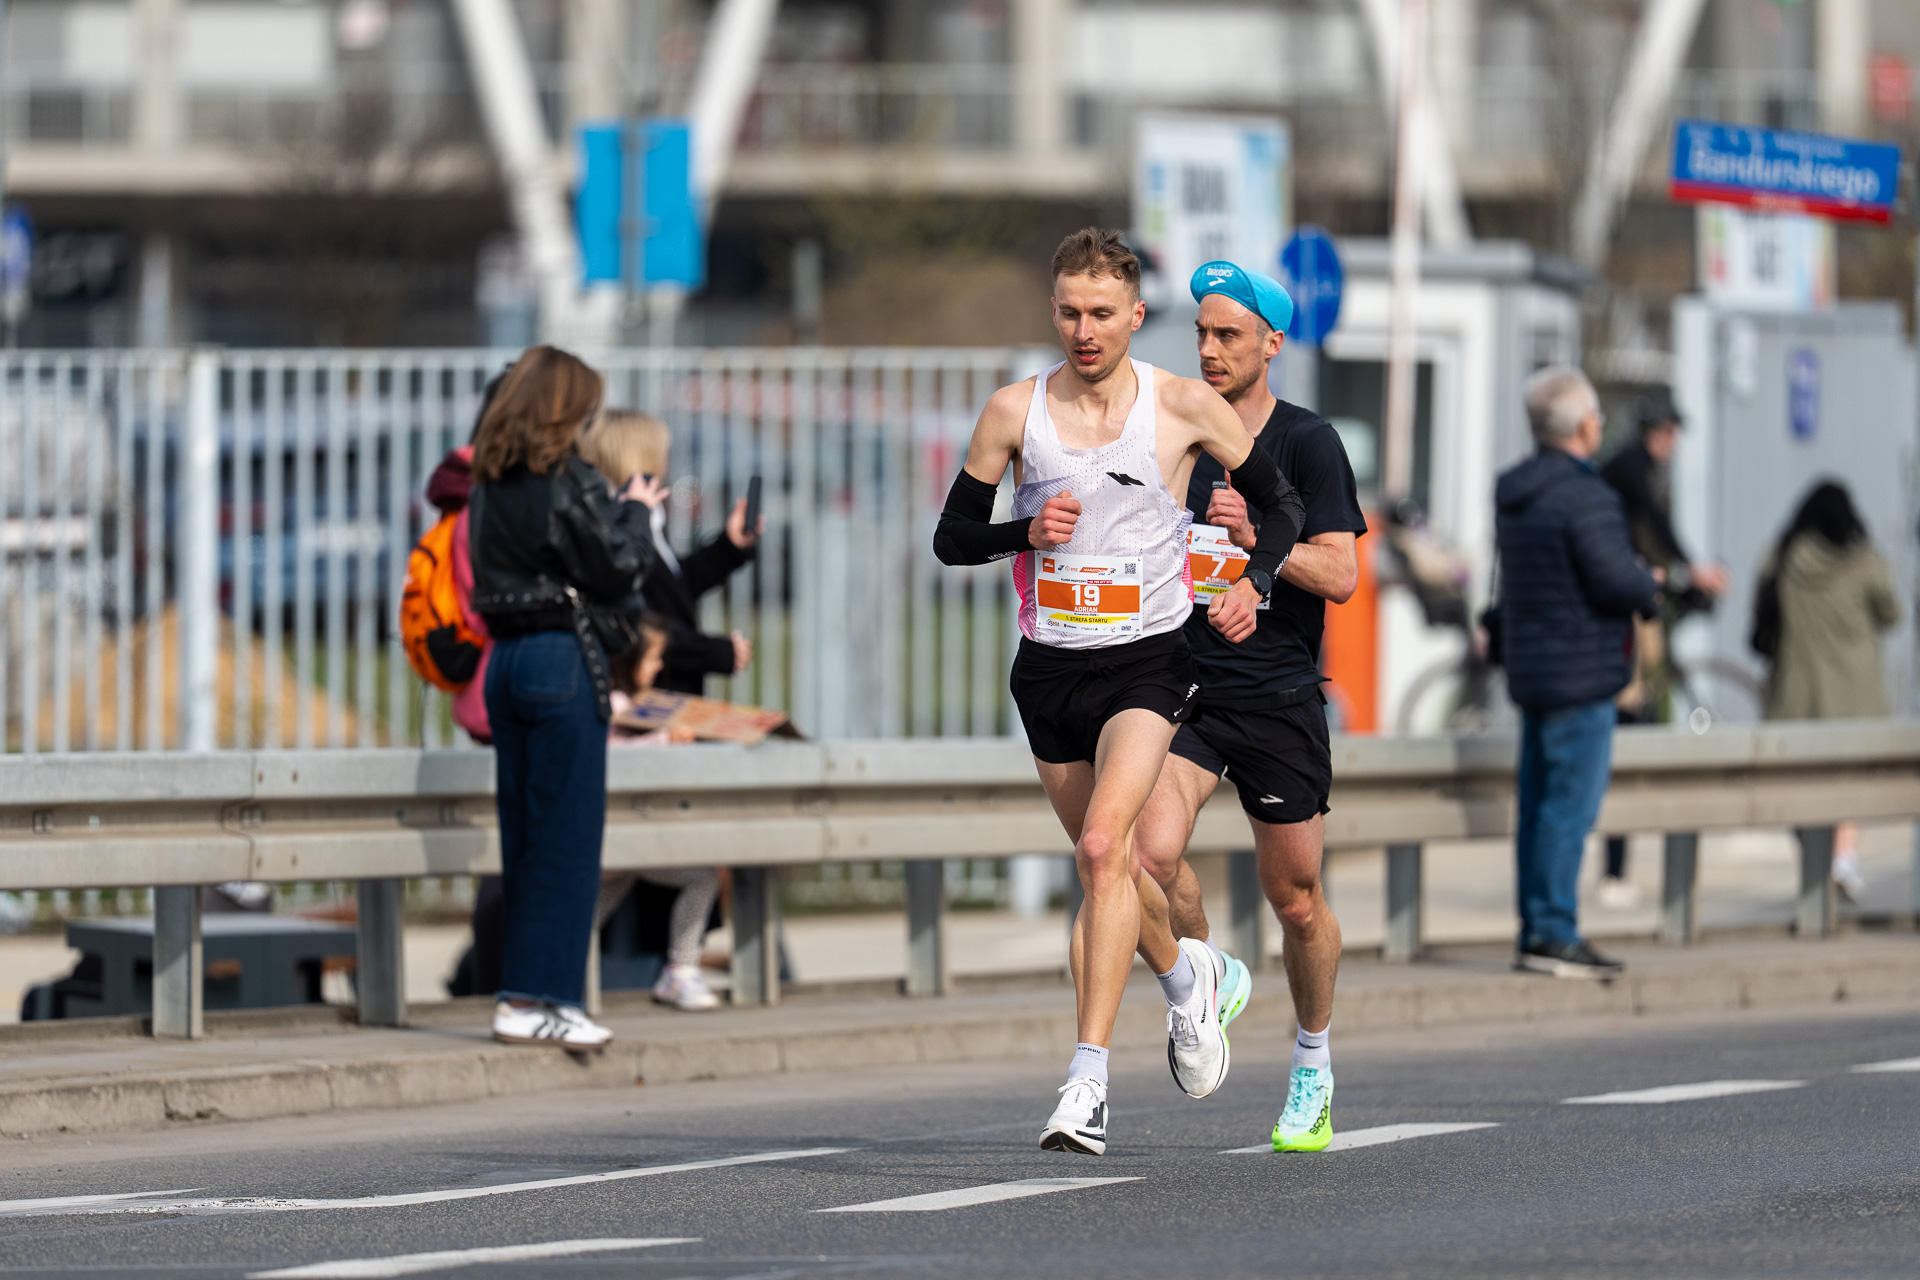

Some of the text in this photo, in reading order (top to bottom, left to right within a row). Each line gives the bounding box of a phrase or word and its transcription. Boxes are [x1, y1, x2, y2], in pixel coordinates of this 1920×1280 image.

[1207, 267, 1234, 278] BROOKS
[1211, 556, 1227, 577] 7
[1205, 576, 1230, 585] FLORIAN
[1071, 584, 1100, 607] 19
